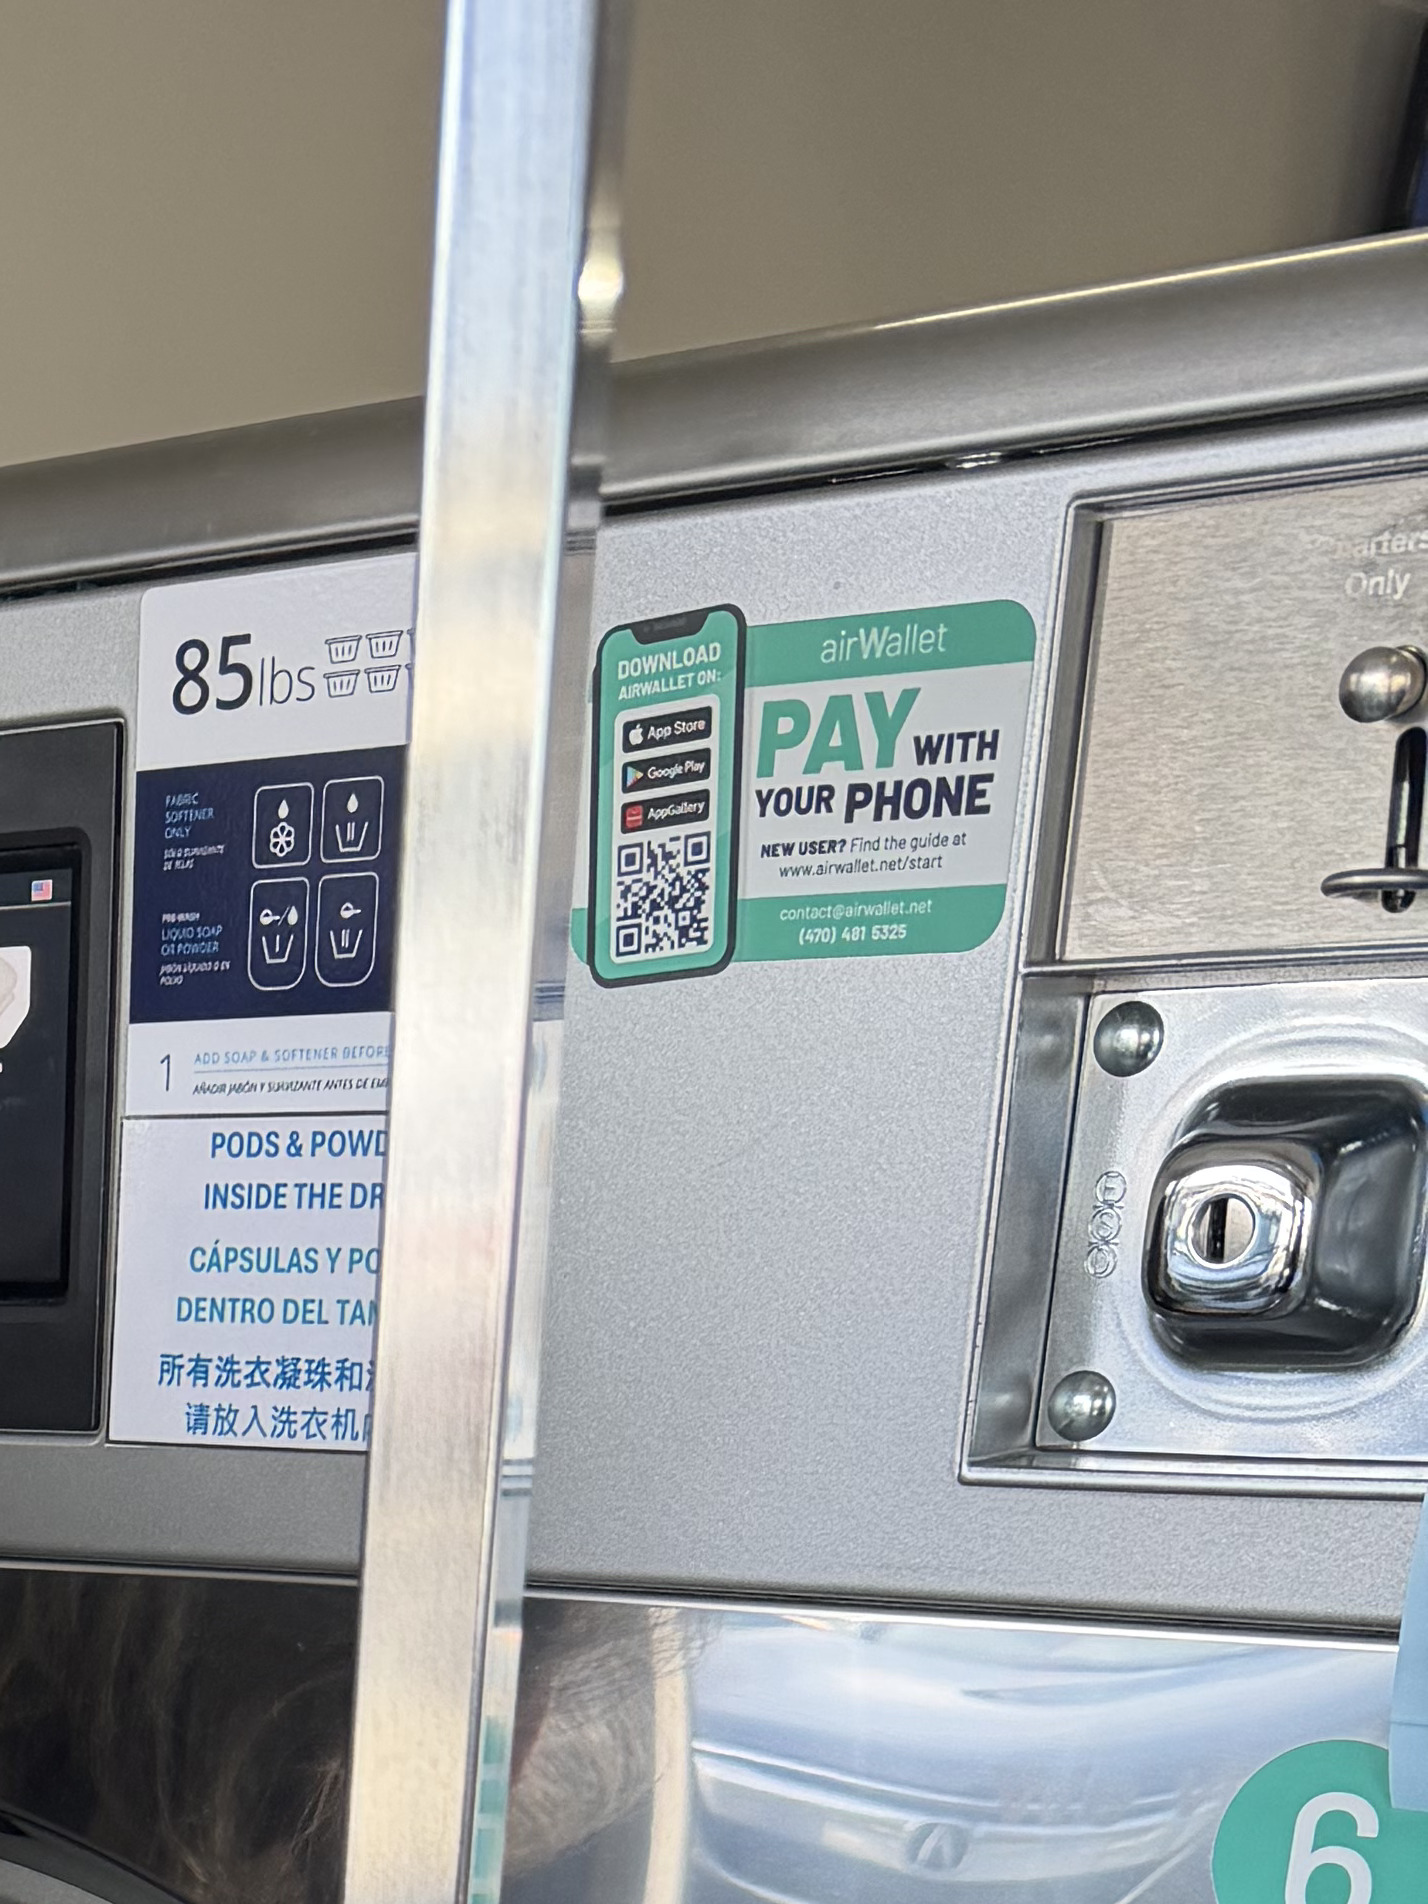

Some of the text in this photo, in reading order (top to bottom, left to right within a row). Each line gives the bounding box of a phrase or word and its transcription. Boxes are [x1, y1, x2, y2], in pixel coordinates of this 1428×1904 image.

[1345, 567, 1412, 601] Only
[819, 623, 948, 664] airWallet
[617, 642, 722, 681] DOWNLOAD
[617, 668, 722, 701] AIRWALLET ON:
[647, 717, 706, 742] App Store
[756, 687, 1000, 779] PAY WITH
[647, 758, 705, 781] Google Play
[647, 800, 705, 821] AppGallery
[755, 773, 995, 824] YOUR PHONE
[165, 807, 214, 824] SOFTENER
[760, 832, 967, 859] NEW USER? Find the guide at
[779, 854, 943, 878] www.airwallet.net/start
[779, 899, 932, 921] contact@airwallet.net
[197, 924, 223, 939] SOAP
[798, 926, 836, 945] (470)
[871, 924, 908, 941] 5325
[194, 1052, 220, 1066] ADD
[224, 1050, 256, 1064] SOAP
[261, 1050, 269, 1062] &
[274, 1047, 337, 1063] SOFTENER
[160, 1054, 171, 1091] 1
[211, 1131, 280, 1158] PODS
[286, 1130, 303, 1158] &
[204, 1182, 385, 1210] INSIDE THE DR
[190, 1239, 381, 1275] CÁPSULAS Y PO
[176, 1296, 275, 1324] DENTRO
[282, 1298, 329, 1325] DEL
[158, 1353, 374, 1392] 所有洗衣凝珠和
